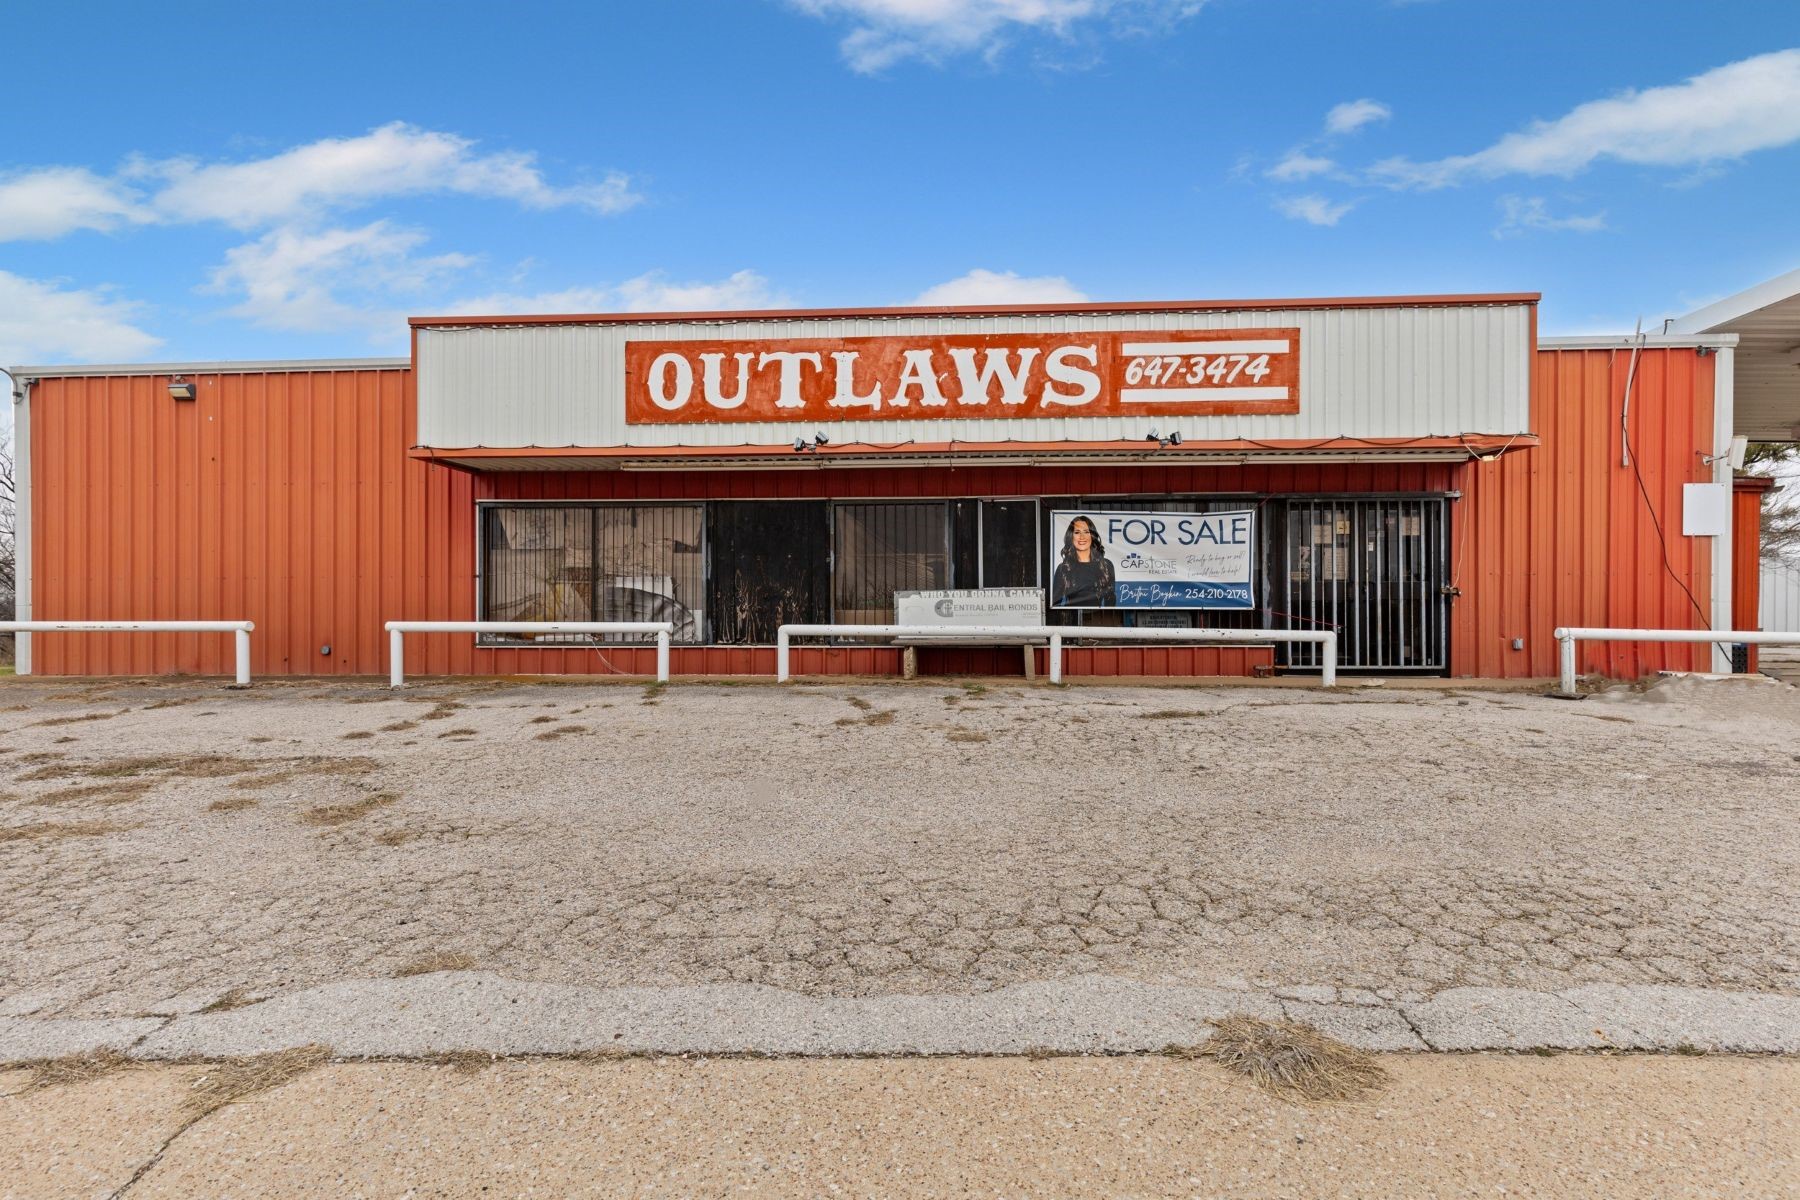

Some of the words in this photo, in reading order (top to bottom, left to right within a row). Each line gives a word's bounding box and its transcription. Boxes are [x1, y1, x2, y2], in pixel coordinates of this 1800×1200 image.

[646, 344, 1101, 411] OUTLAWS
[1124, 353, 1270, 386] 647-3474
[1108, 518, 1168, 545] FOR
[1178, 518, 1246, 545] SALE
[1120, 556, 1177, 569] CAPSTONE
[920, 591, 945, 599] WHO
[971, 590, 1006, 598] GONNA
[1009, 589, 1043, 598] CALL?
[1185, 588, 1248, 600] 254-210-2178
[988, 603, 1005, 611] BAIL
[1009, 603, 1038, 611] BONDS
